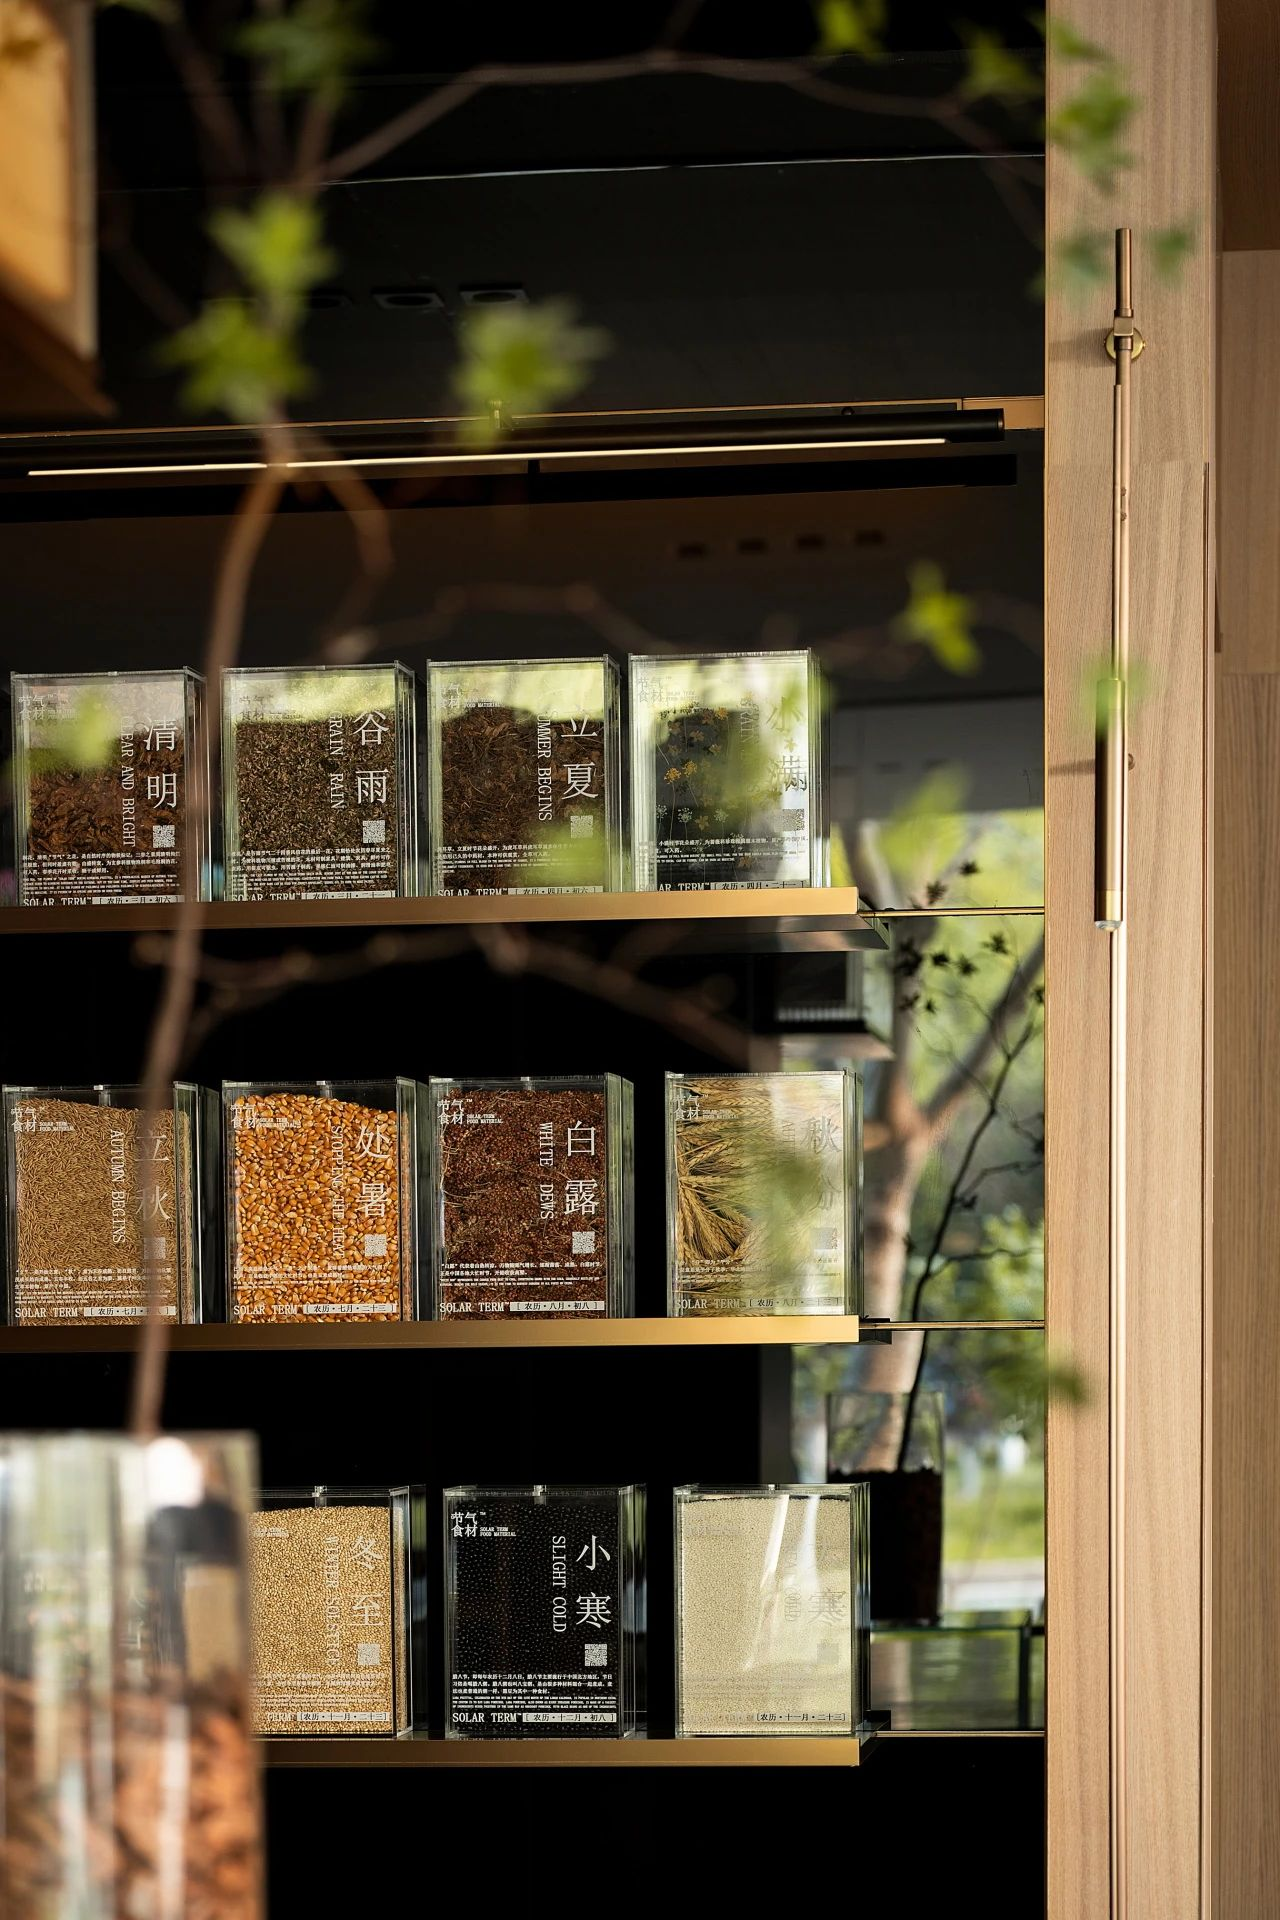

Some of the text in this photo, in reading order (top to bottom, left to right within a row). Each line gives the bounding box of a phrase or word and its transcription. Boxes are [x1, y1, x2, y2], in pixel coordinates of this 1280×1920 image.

[121, 765, 135, 790] AND
[143, 716, 178, 808] 清明
[329, 710, 345, 809] GRAIN RAIN
[352, 709, 389, 804] 谷雨
[561, 711, 599, 800] 立夏
[537, 767, 553, 821] BEGINS
[122, 797, 136, 847] BRIGHT
[12, 1119, 37, 1132] 食材
[437, 1111, 464, 1125] 食材
[110, 1129, 126, 1243] AUTUMN BEGINS
[355, 1125, 391, 1217] 处暑
[540, 1122, 554, 1220] WHITE DEWS
[564, 1120, 600, 1215] 白露
[332, 1195, 345, 1219] THE
[333, 1226, 345, 1258] HEAT
[15, 1307, 47, 1318] SOLAR
[233, 1304, 265, 1315] SOLAR
[440, 1302, 472, 1313] SOLAR
[451, 1524, 478, 1537] 食材
[350, 1535, 384, 1626] 冬至
[552, 1535, 566, 1632] SLIGHT COLD
[576, 1534, 611, 1629] 小寒
[452, 1712, 485, 1723] SOLAR
